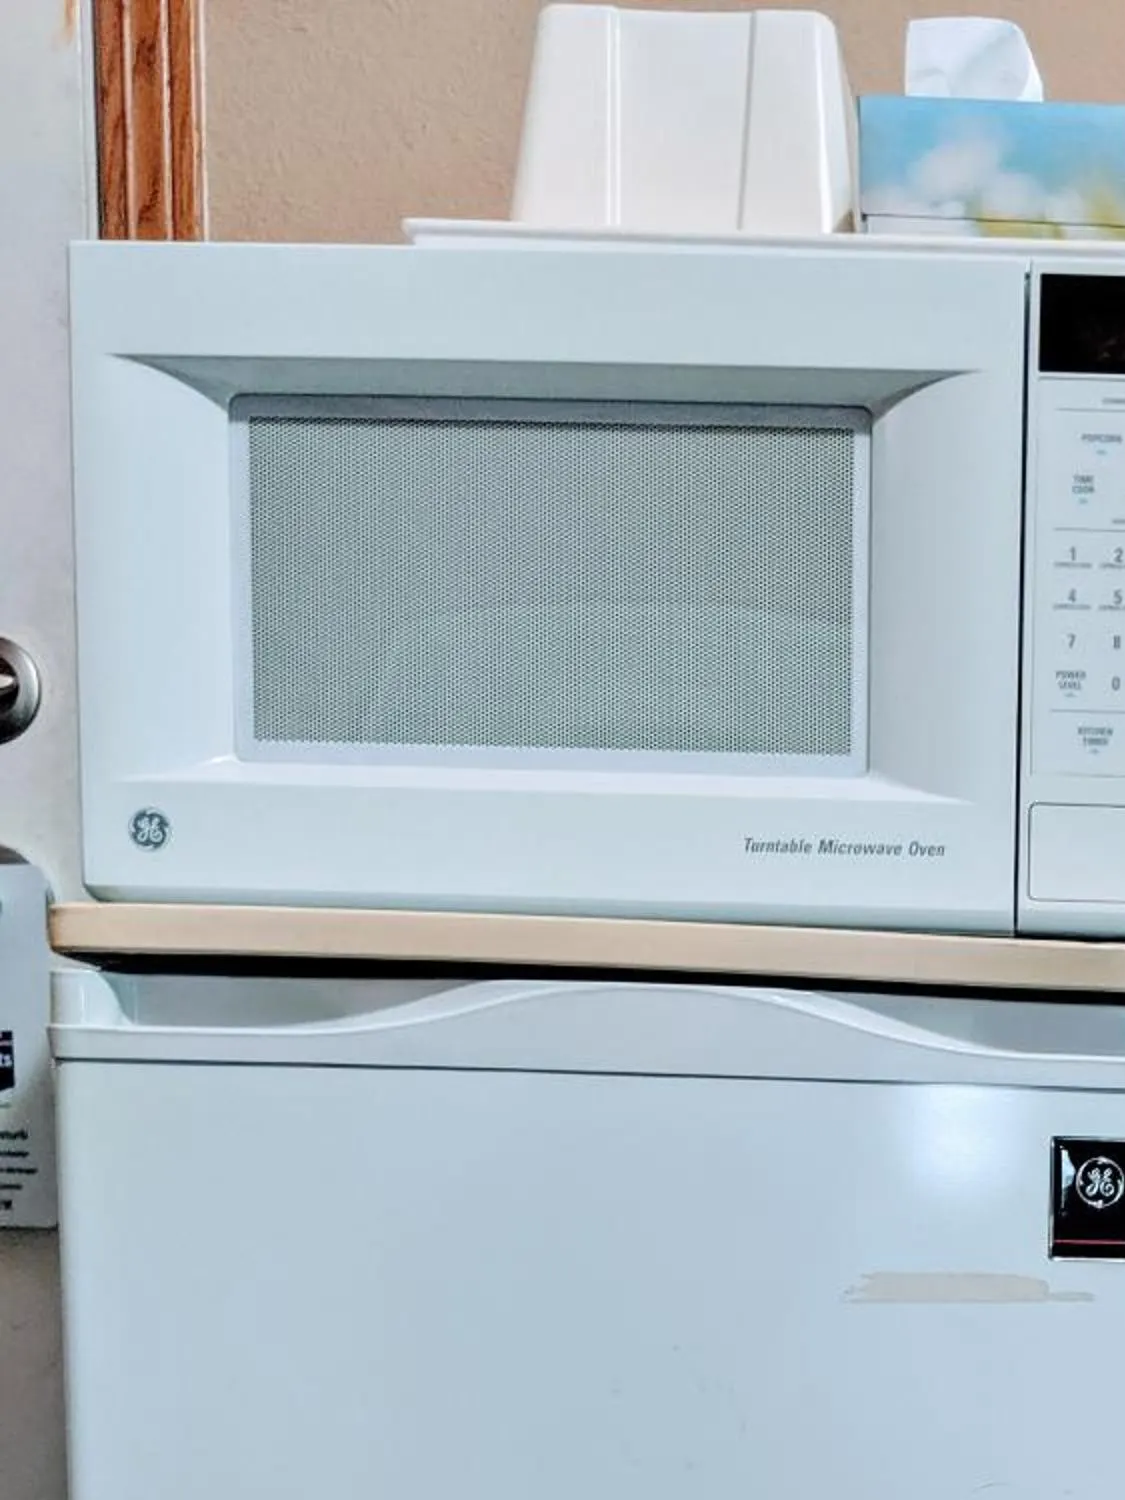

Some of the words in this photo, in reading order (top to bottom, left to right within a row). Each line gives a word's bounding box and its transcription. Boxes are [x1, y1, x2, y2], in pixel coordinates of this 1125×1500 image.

[1070, 546, 1077, 561] 1
[1113, 547, 1123, 563] 2
[1067, 588, 1077, 603] 4
[1113, 589, 1123, 604] 5
[1067, 633, 1076, 649] 7
[1113, 635, 1121, 649] 8
[1111, 675, 1120, 691] 0
[743, 837, 813, 855] Turntable
[817, 839, 901, 856] Microwave
[908, 840, 946, 857] Oven
